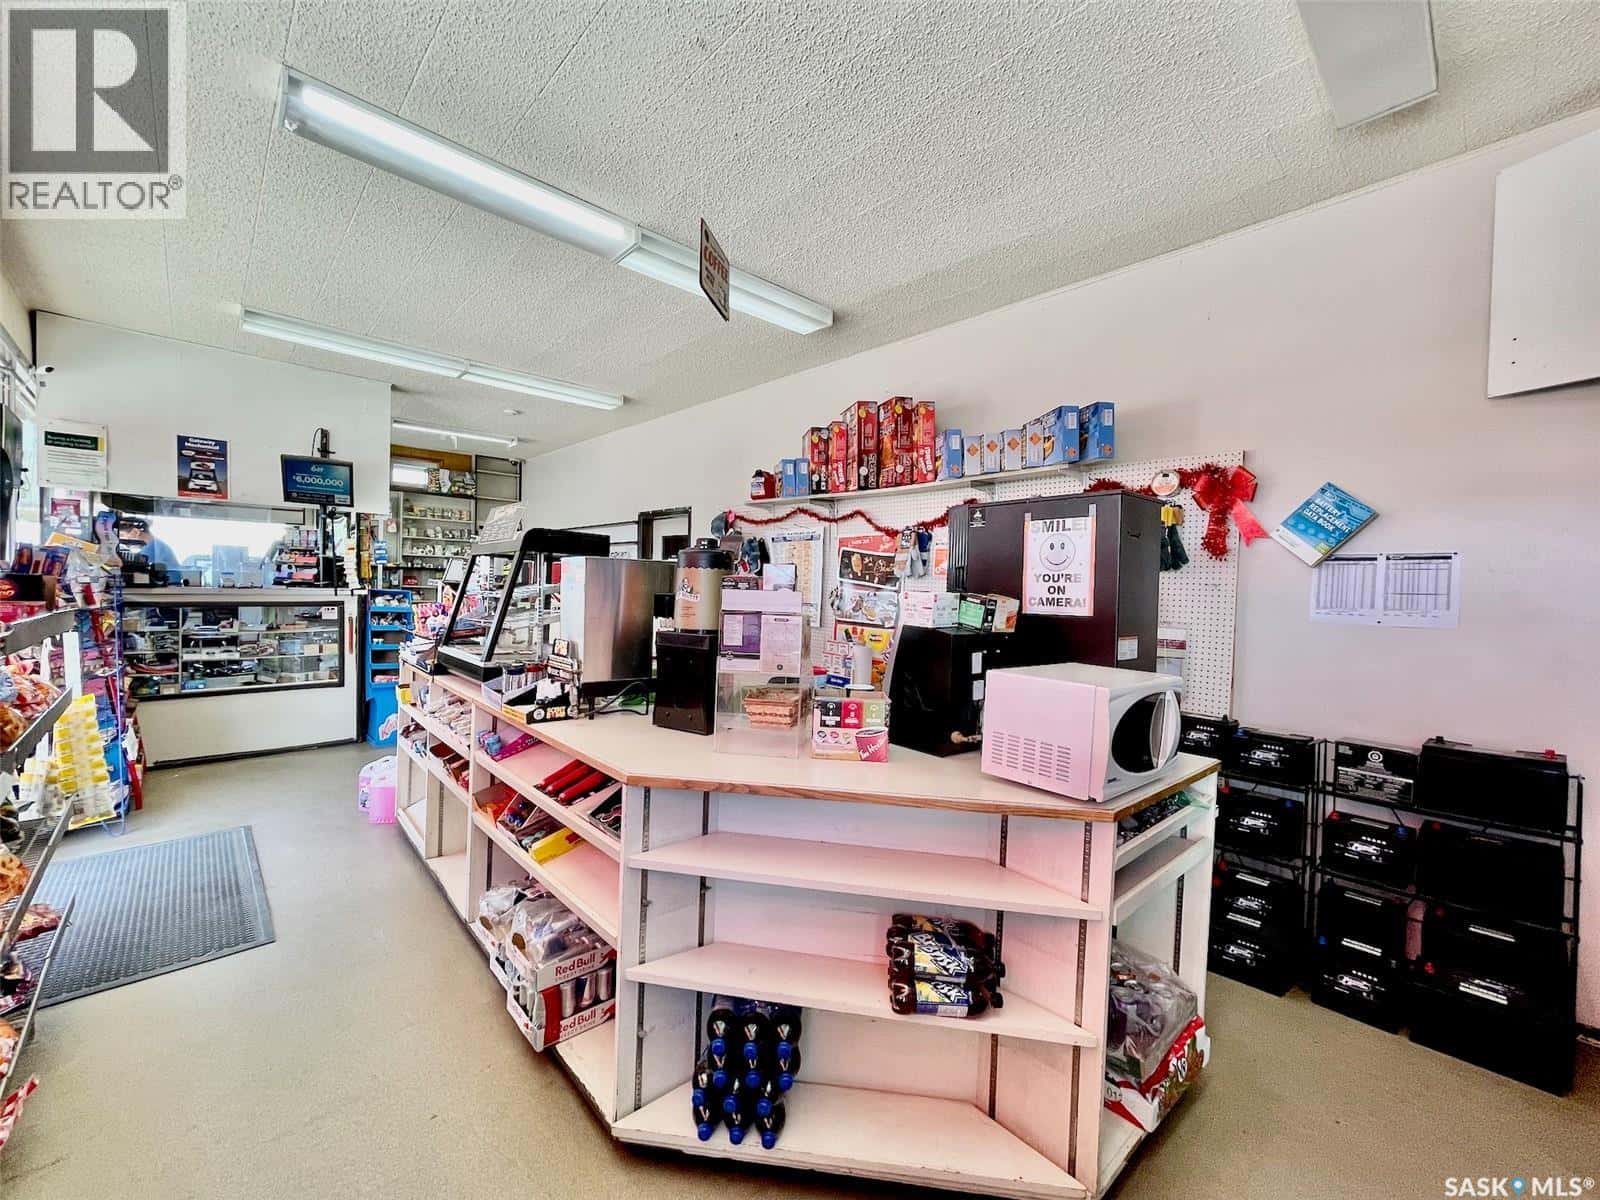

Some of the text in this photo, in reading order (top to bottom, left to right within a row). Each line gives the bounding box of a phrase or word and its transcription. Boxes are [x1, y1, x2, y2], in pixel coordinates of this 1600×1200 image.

[1030, 519, 1088, 534] SMILE!
[1317, 518, 1336, 532] BOOK
[1034, 573, 1082, 584] YOU'RE
[1047, 585, 1066, 595] ON
[1028, 597, 1087, 608] CAMERA!
[555, 953, 595, 977] Red Bull
[577, 1009, 596, 1023] Bull
